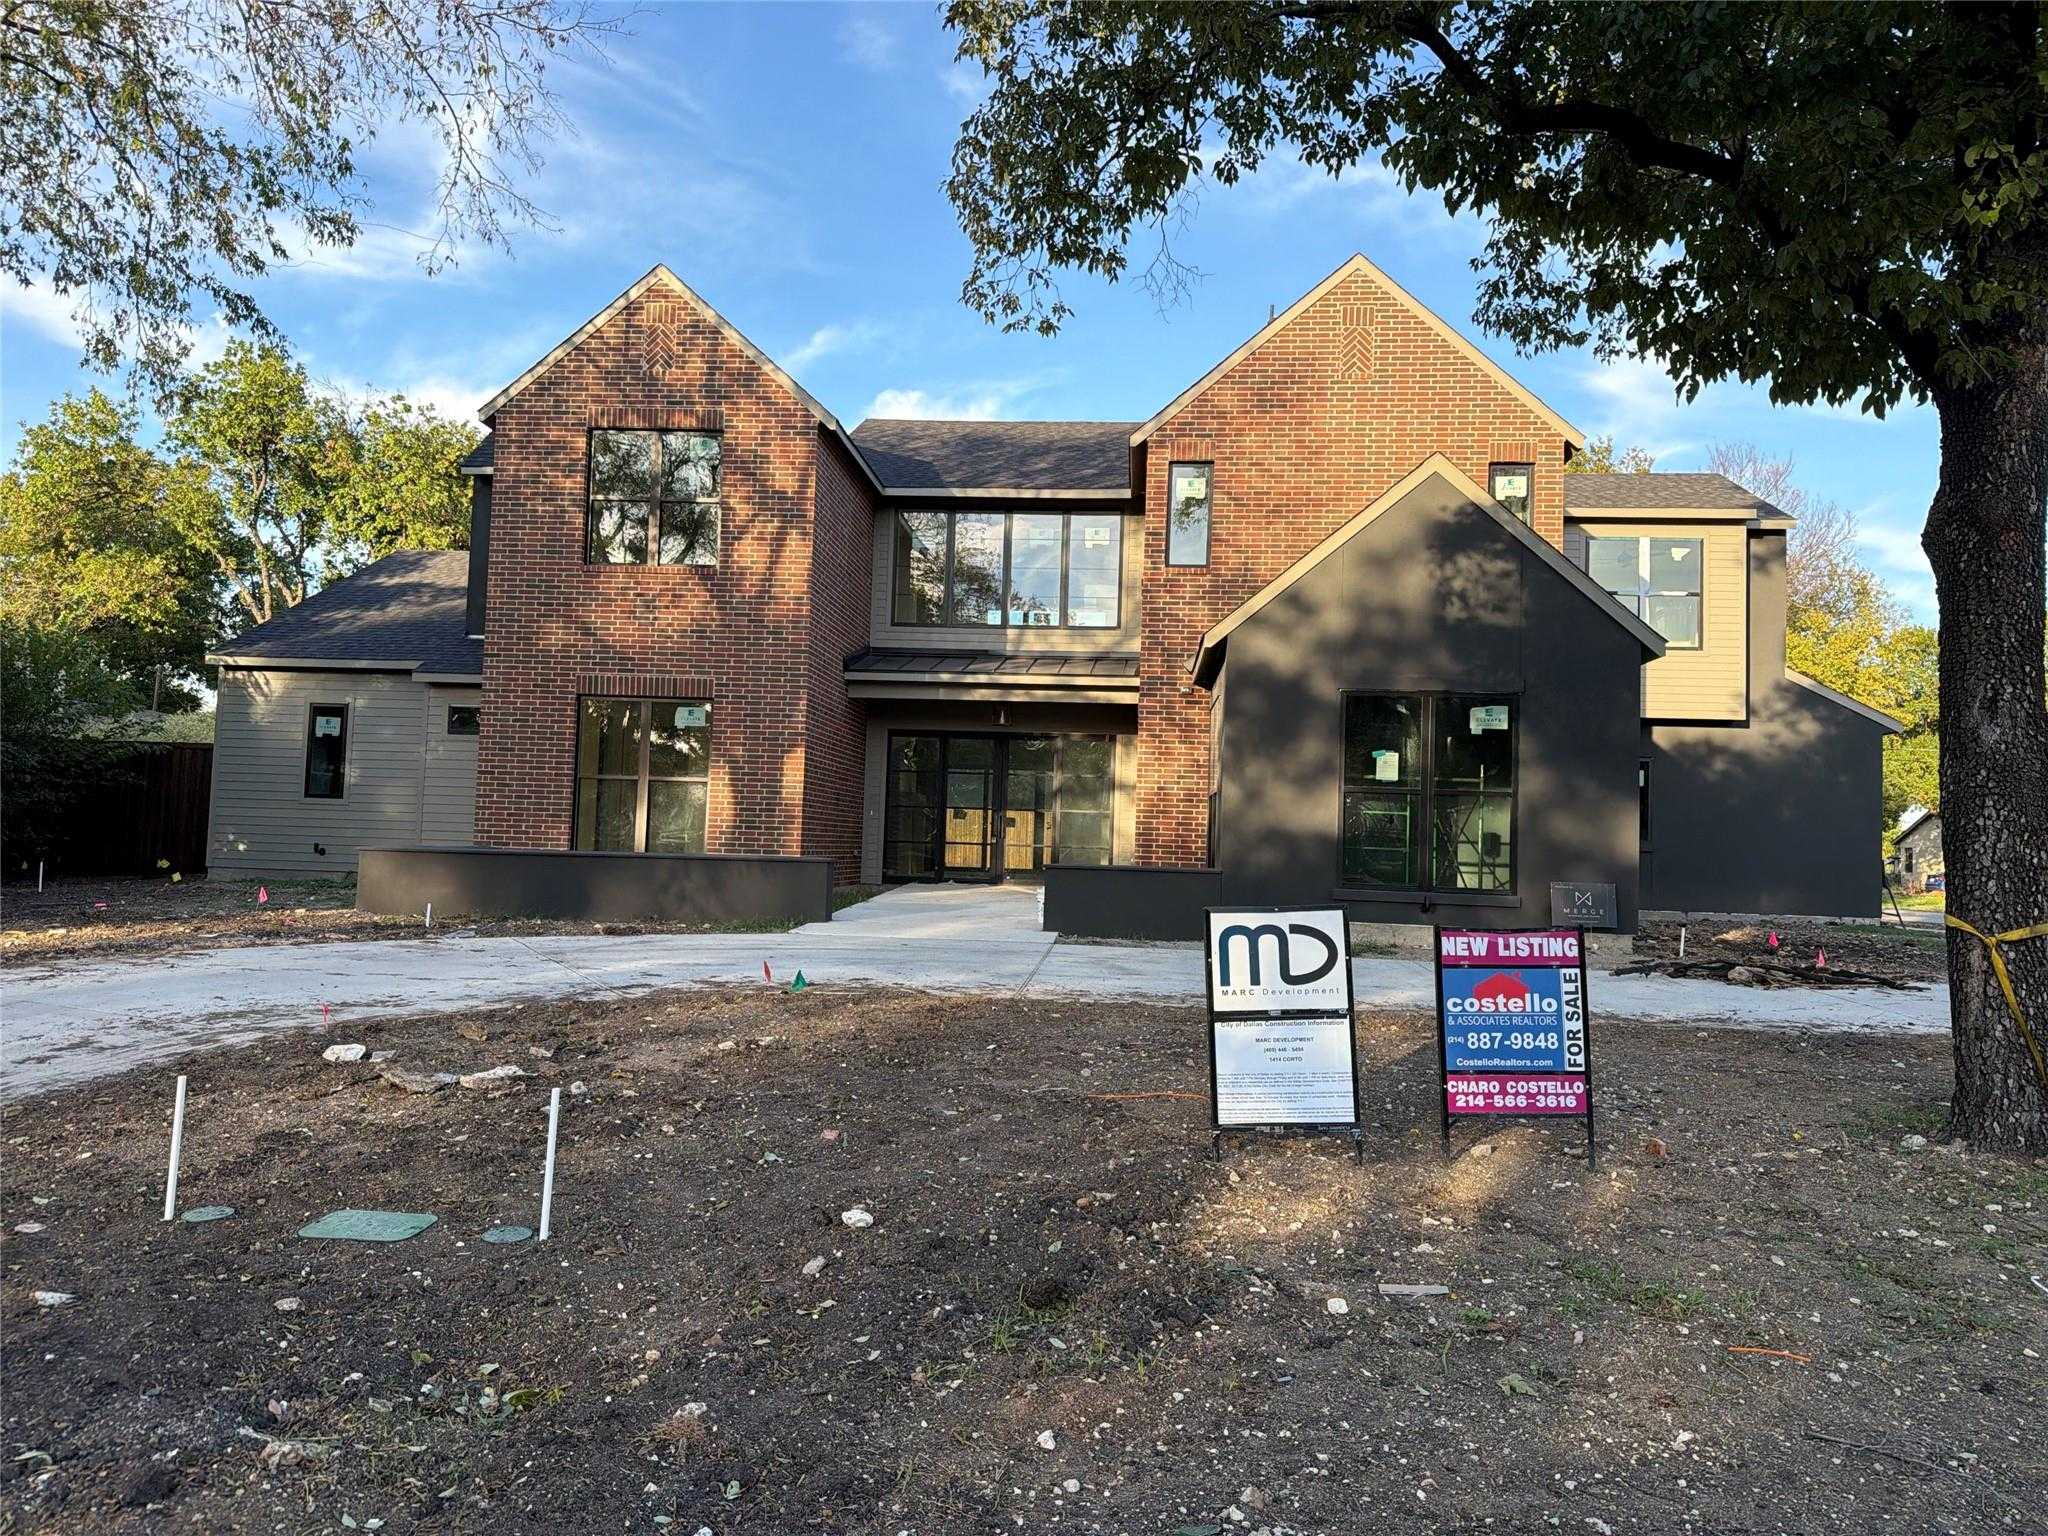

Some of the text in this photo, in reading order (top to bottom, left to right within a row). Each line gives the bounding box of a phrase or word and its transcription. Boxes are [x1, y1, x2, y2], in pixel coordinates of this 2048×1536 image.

[1563, 907, 1605, 915] MERGE
[1441, 936, 1579, 957] NEW LISTING
[1262, 987, 1340, 996] Development
[1446, 993, 1558, 1013] costello
[1220, 1021, 1233, 1029] City
[1447, 1015, 1558, 1026] & ASSOCIATES REALTORS
[1563, 972, 1583, 1068] FOR SALE
[1447, 1032, 1559, 1050] (214) 887-9848
[1456, 1057, 1553, 1067] CostelloRealtors.com
[1447, 1081, 1585, 1094] CHARO COSTELLO
[1455, 1094, 1577, 1108] 214-566-3616
